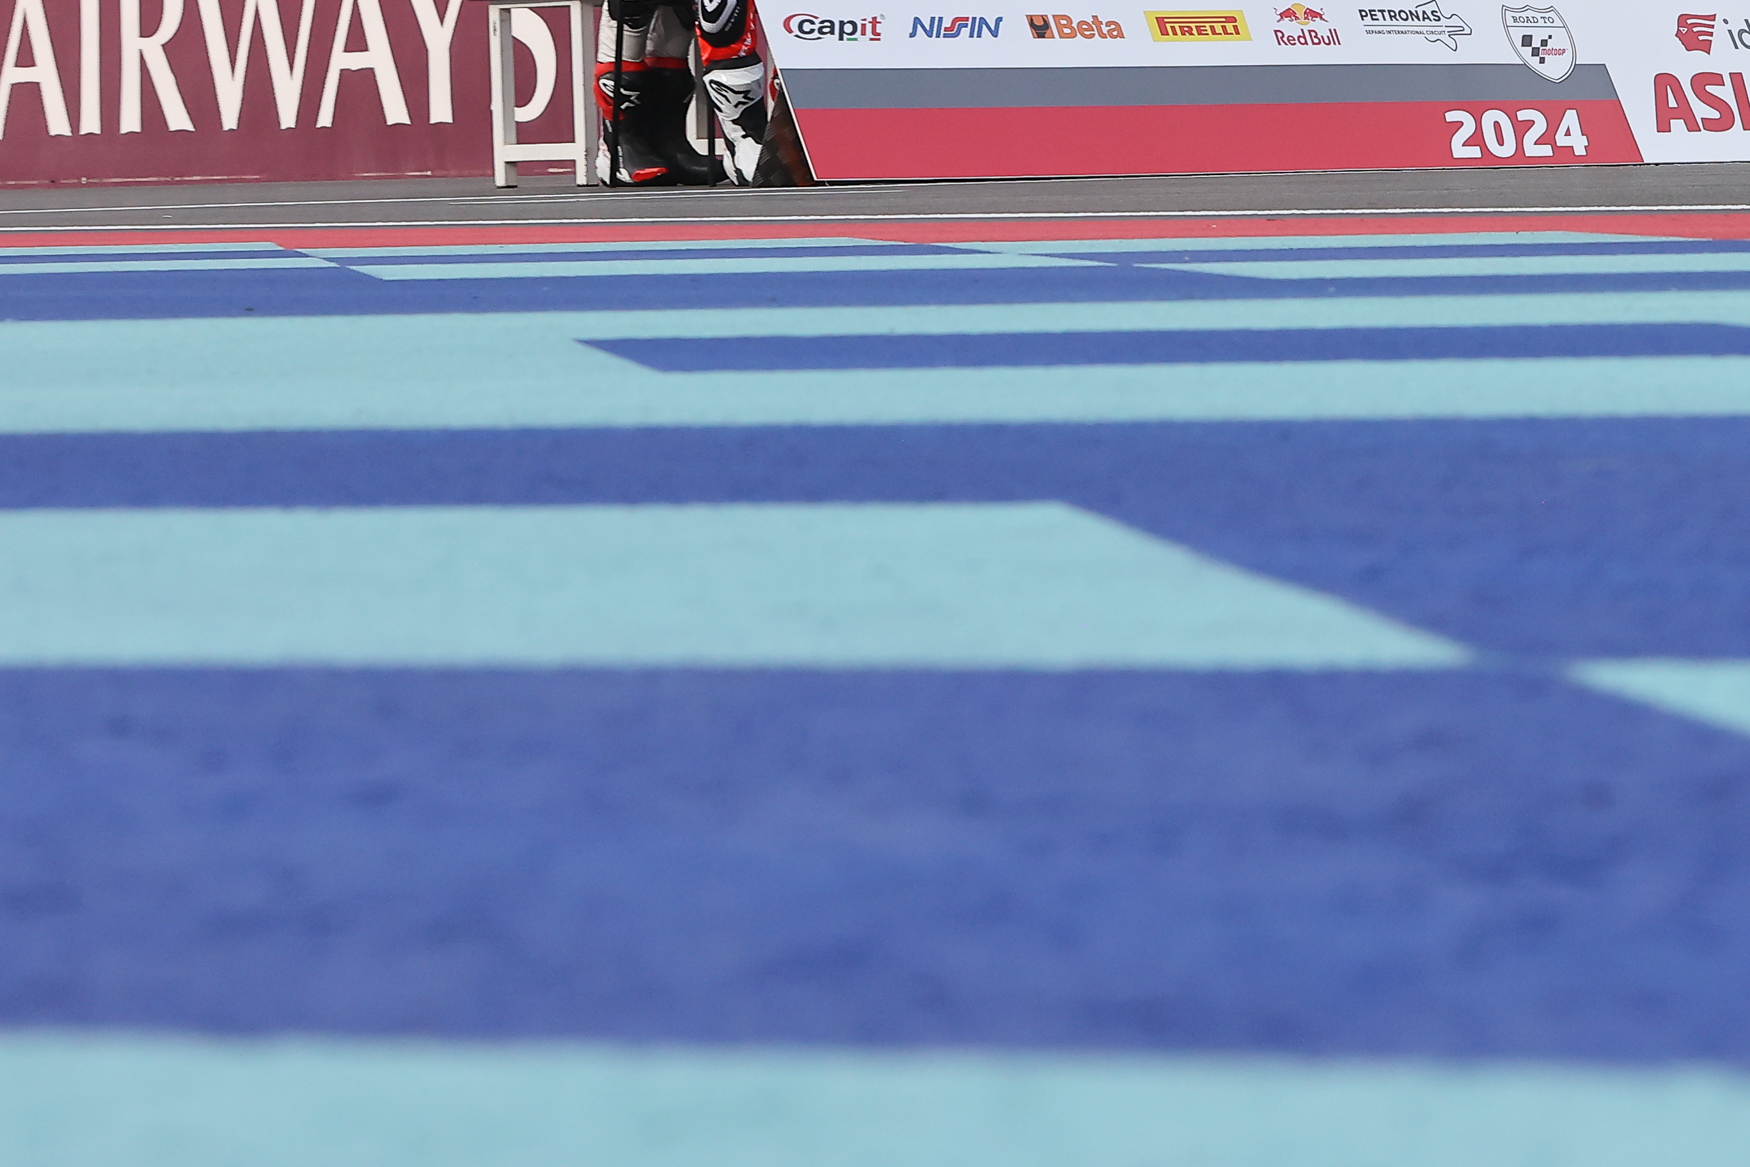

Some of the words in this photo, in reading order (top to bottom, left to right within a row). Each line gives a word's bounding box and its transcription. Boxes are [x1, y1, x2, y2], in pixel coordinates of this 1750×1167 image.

[1358, 8, 1441, 23] PETRONAS
[1511, 15, 1539, 24] ROAD
[1541, 16, 1555, 24] TO
[1051, 14, 1126, 39] Beta
[1155, 15, 1241, 36] PIRELLI
[1273, 28, 1309, 46] Red
[1310, 28, 1342, 46] Bull
[1444, 108, 1589, 159] 2024
